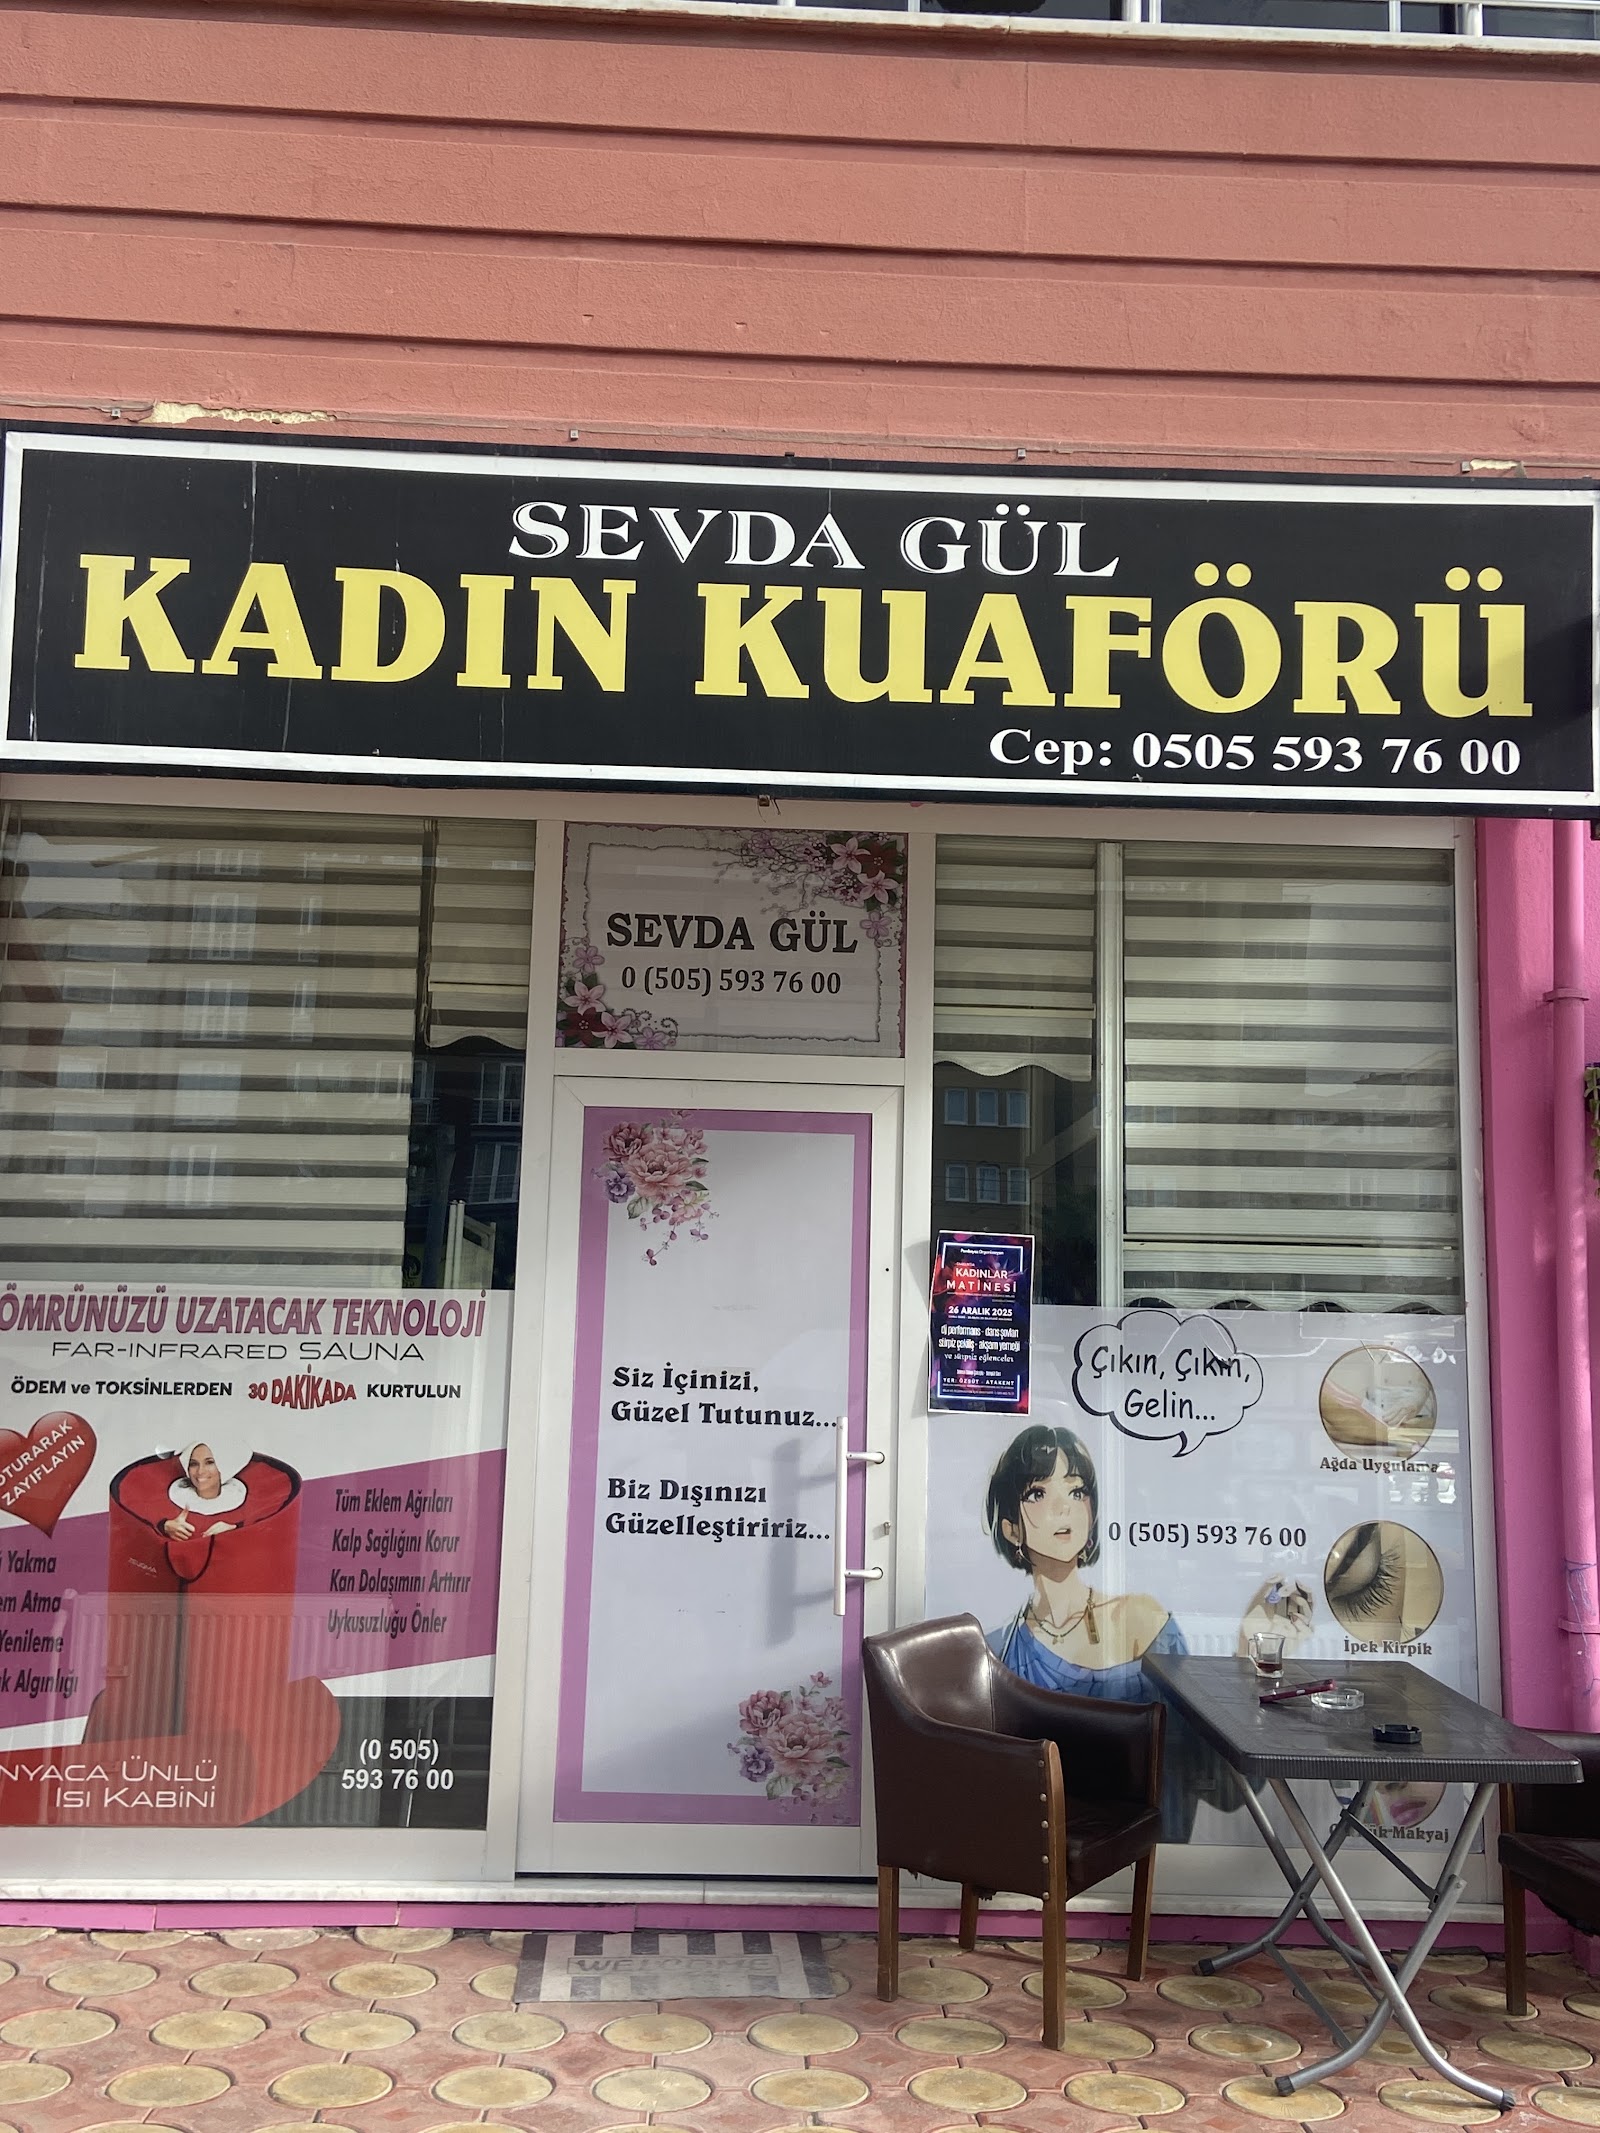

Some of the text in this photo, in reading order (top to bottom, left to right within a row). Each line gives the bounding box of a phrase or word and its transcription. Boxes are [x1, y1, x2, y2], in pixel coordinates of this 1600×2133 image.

[508, 501, 1120, 577] SEVDA GÜL
[74, 554, 1533, 718] KADIN KUAFÖRÜ
[989, 728, 1522, 776] Cep: 0505 593 76 00
[607, 911, 858, 954] SEVDA GÜL
[622, 967, 841, 997] 0 (505) 593 76 00
[946, 1280, 1017, 1293] MATİNESİ
[956, 1268, 1008, 1279] KADINLAR
[0, 1283, 486, 1337] ÖMRÜNÜZÜ UZATACAK TEKNOLOJİ
[948, 1306, 1013, 1317] 26 ARALIK 2025
[52, 1342, 425, 1361] FAR-INFRARED SAUNA
[1091, 1345, 1250, 1383] Çıkın, Çıkın,
[11, 1363, 461, 1410] ÖDEM ve TOKSİNLERDEN 30 DAKİKADA KURTULUN
[612, 1362, 760, 1395] Siz İçinizi,
[611, 1400, 837, 1427] Güzel Tutunuz...
[1124, 1388, 1216, 1421] Gelin...
[1, 1435, 85, 1507] ZAYIFLAYIN
[1320, 1457, 1357, 1472] Ağda
[335, 1488, 453, 1519] Tüm Eklem Ağrıları
[607, 1478, 767, 1507] Biz Dışınızı
[605, 1512, 830, 1543] Güzelleştiririz...
[1109, 1522, 1307, 1548] 0 (505) 593 76 00
[332, 1530, 459, 1559] Kalp Sağlığını Korur
[7, 1550, 57, 1573] Yakma
[330, 1573, 471, 1598] Kan Dolaşımını Arttırır
[21, 1590, 62, 1613] Atma
[327, 1608, 447, 1637] Uykusuzluğu Önler
[1344, 1636, 1432, 1656] İpek Kirpik
[14, 1669, 78, 1699] Algınlığı
[359, 1738, 440, 1765] (0 505)
[122, 1756, 218, 1781] ÜNLÜ
[341, 1769, 454, 1791] 593 76 00
[56, 1786, 216, 1809] ISI KABİNİ
